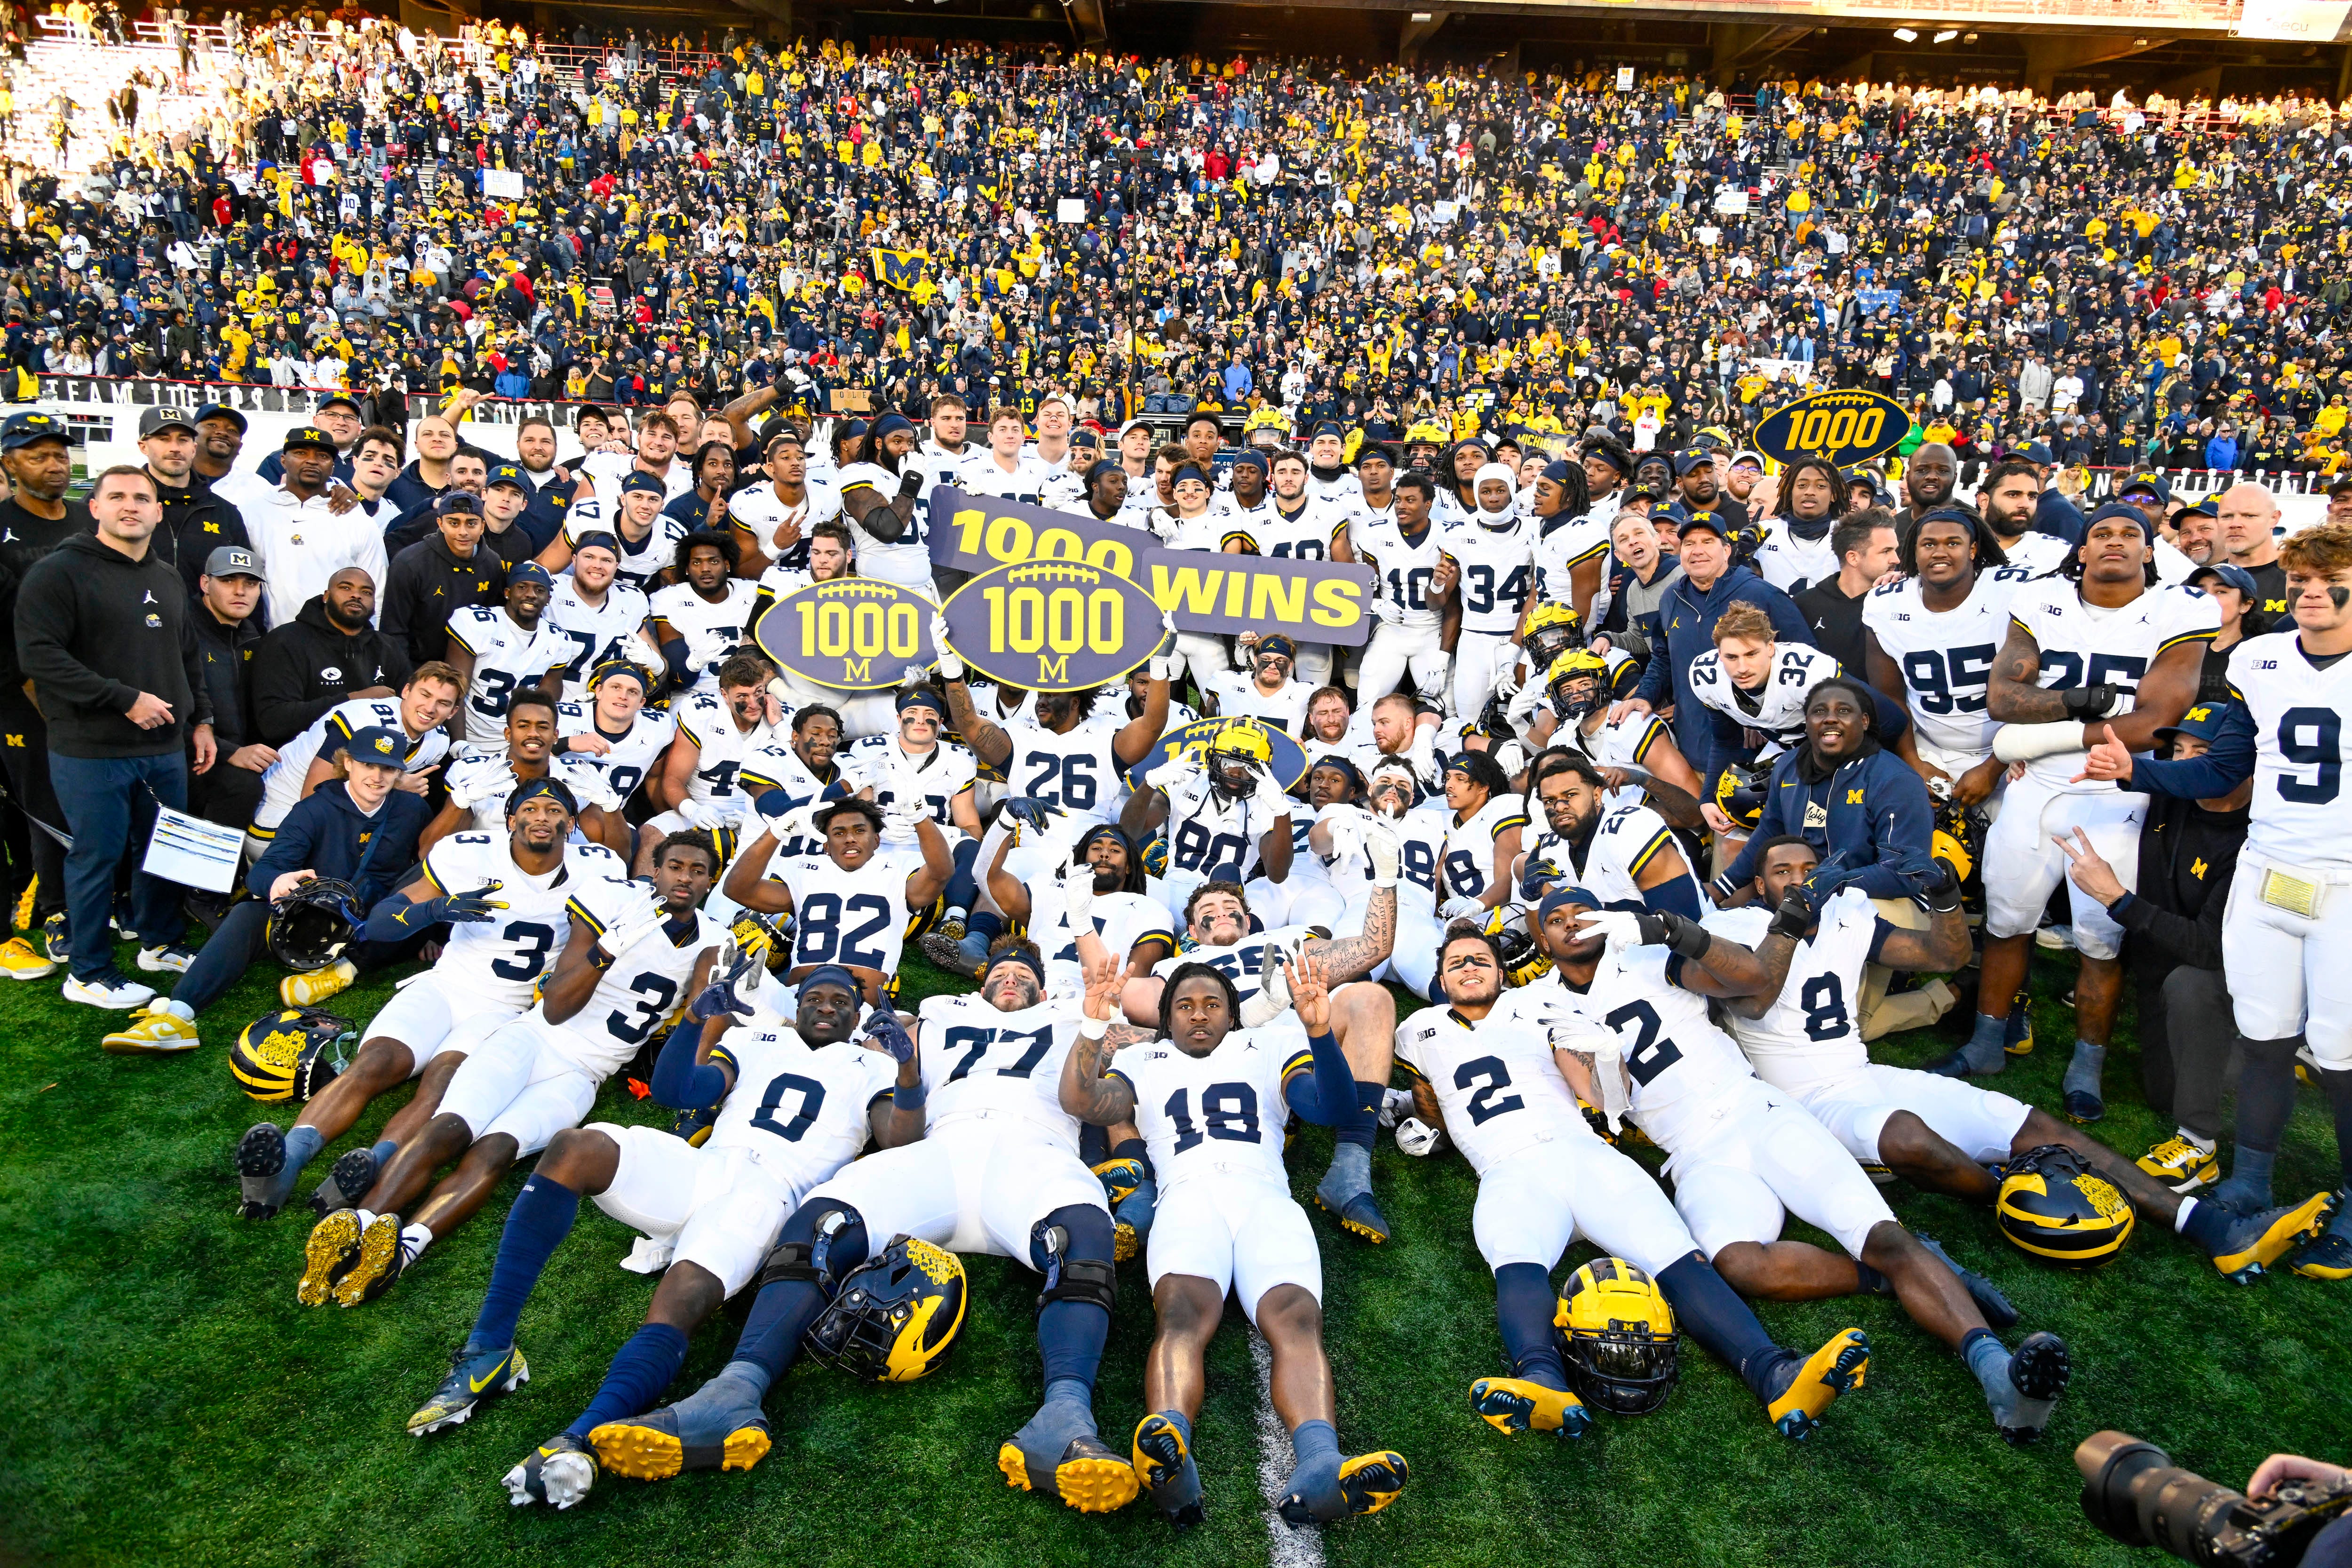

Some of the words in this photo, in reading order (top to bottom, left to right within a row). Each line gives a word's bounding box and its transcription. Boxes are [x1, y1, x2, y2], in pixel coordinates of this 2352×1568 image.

[2272, 21, 2309, 32] secu
[985, 56, 993, 64] 12
[742, 63, 747, 72] 9
[1448, 87, 1454, 96] 9
[978, 185, 997, 202] M
[1197, 193, 1207, 202] 10
[345, 198, 355, 208] 10
[668, 216, 676, 229] 7
[501, 232, 511, 242] 10
[708, 233, 715, 241] 4
[358, 252, 362, 263] 1
[882, 255, 925, 288] M
[1545, 263, 1555, 274] 96
[1299, 271, 1309, 284] 10
[1020, 290, 1024, 300] 9
[1612, 303, 1618, 312] 9
[286, 312, 300, 324] 18
[2314, 316, 2323, 326] 2
[1334, 326, 1341, 335] 2
[255, 357, 270, 368] M
[1209, 375, 1217, 386] 9
[1672, 370, 1679, 382] 7
[650, 383, 663, 393] M
[1474, 395, 1485, 413] 4
[2280, 394, 2287, 404] 4
[1020, 398, 1033, 413] 13
[163, 410, 180, 419] M
[1374, 415, 1386, 424] M
[1459, 419, 1465, 431] 9
[1785, 407, 1887, 450] 1000
[304, 430, 320, 441] M
[1687, 449, 1702, 458] M
[501, 467, 516, 477] M
[1853, 468, 1868, 477] M
[2137, 472, 2156, 484] M
[1636, 484, 1649, 492] M
[552, 495, 566, 507] M
[1655, 503, 1670, 511] M
[1692, 511, 1711, 521] M
[203, 522, 221, 533] M
[233, 554, 249, 565] M
[477, 581, 489, 592] M
[1387, 567, 1434, 611] 10
[1467, 565, 1532, 614] 34
[1151, 564, 1362, 628] WINS
[2263, 599, 2287, 612] M
[983, 587, 1124, 654] 1000
[796, 601, 919, 658] 1000
[843, 658, 872, 683] M
[1037, 654, 1069, 683] M
[1778, 653, 1816, 687] 32
[1902, 643, 1999, 715] 95
[2184, 708, 2211, 722] M
[6, 734, 26, 747] M
[2277, 707, 2342, 805] 9
[1025, 750, 1098, 811] 26
[1846, 789, 1865, 804] M
[1600, 804, 1643, 836] 28
[359, 833, 373, 844] M
[1174, 818, 1245, 878] 80
[1445, 849, 1486, 899] 8
[2190, 856, 2209, 880] M
[796, 893, 891, 971] 82
[491, 920, 555, 982] 3
[606, 971, 678, 1044] 3
[1800, 971, 1850, 1043] 8
[1604, 998, 1685, 1089] 2
[943, 1023, 1054, 1086] 77
[1453, 1054, 1526, 1127] 2
[748, 1072, 826, 1143] 0
[1164, 1081, 1262, 1156] 18
[1623, 1323, 1635, 1332] M
